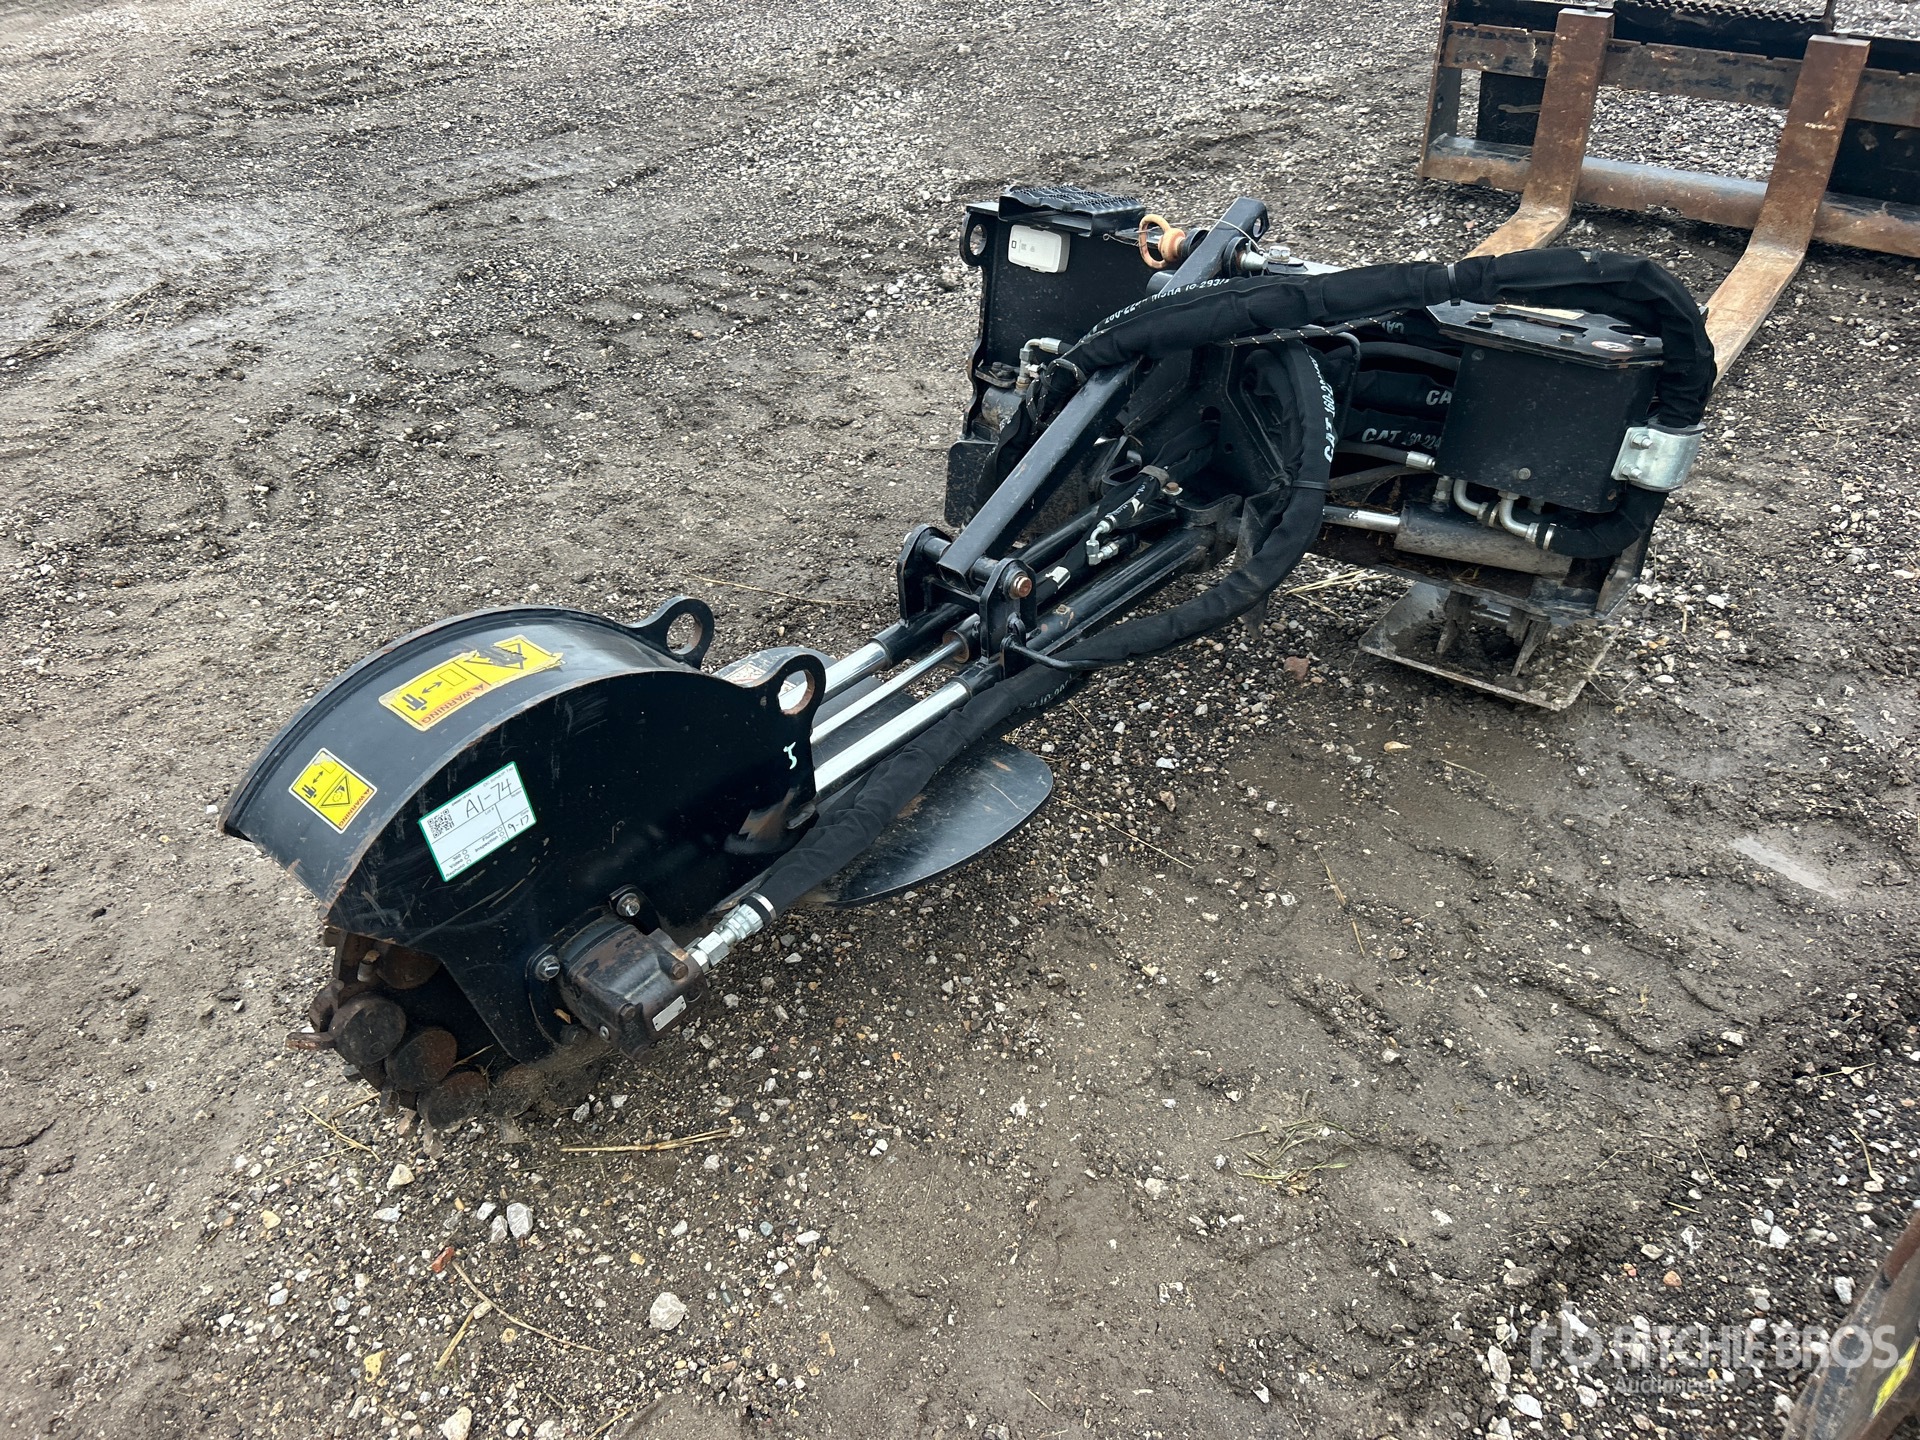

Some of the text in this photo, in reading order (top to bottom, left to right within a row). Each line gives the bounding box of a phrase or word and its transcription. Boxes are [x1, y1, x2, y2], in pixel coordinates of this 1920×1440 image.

[1425, 389, 1453, 406] CA
[1361, 427, 1402, 444] CAT
[421, 690, 475, 724] WARNING
[338, 795, 365, 827] WARNING
[474, 835, 499, 853] Inspection
